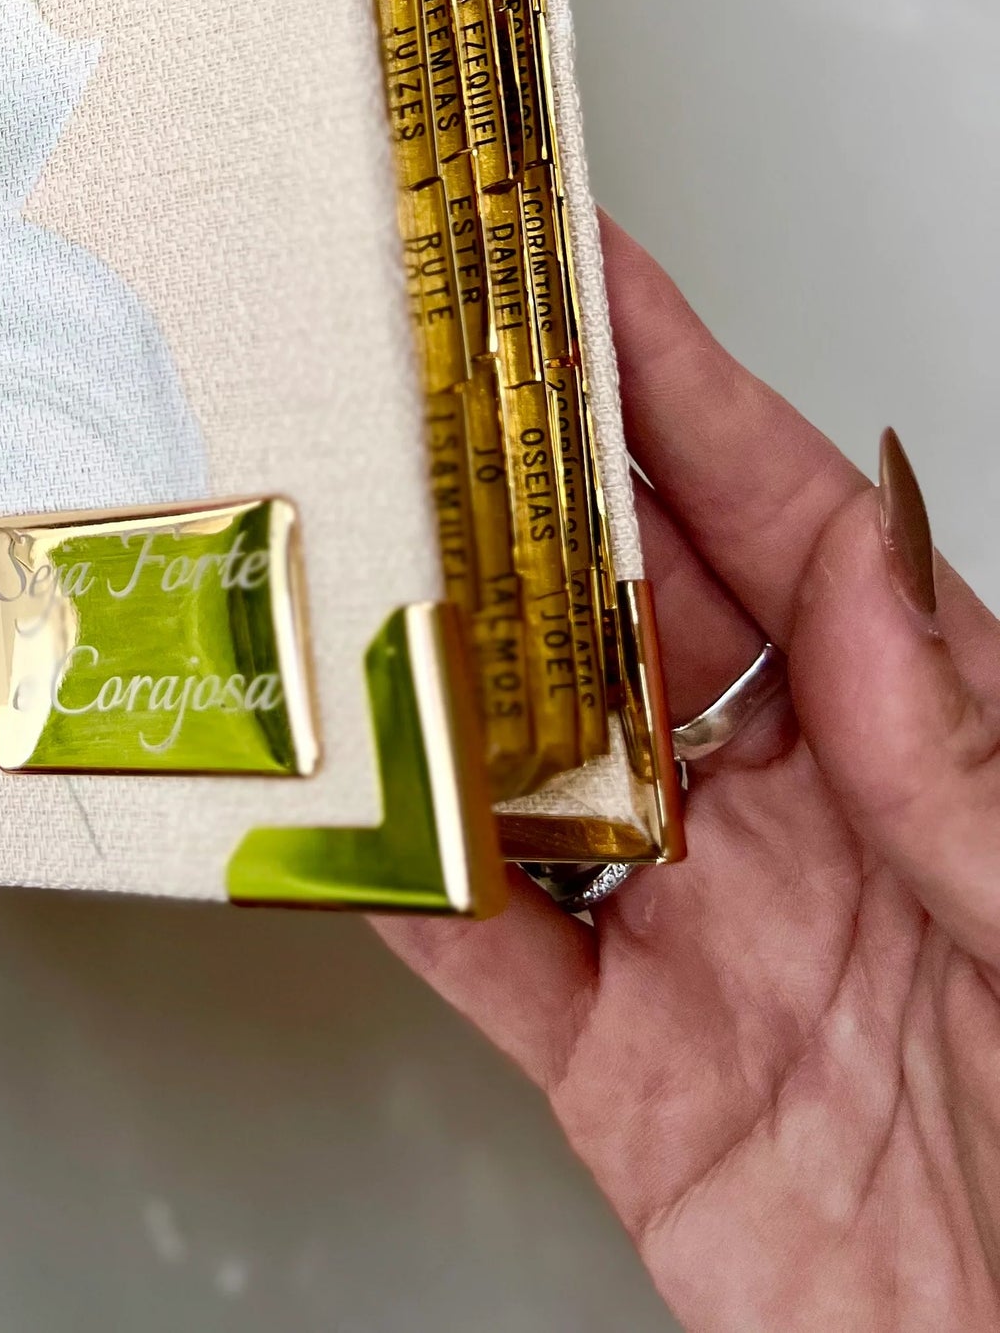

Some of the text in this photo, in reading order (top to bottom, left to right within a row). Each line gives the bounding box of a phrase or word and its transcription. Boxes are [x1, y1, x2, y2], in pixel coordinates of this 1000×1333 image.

[394, 26, 426, 140] JUÍZES
[463, 20, 497, 147] EZEQUIEL
[417, 232, 454, 324] RUTE
[449, 195, 481, 305] ESTER
[490, 222, 523, 331] DANIEL
[474, 447, 506, 483] JÓ
[520, 428, 555, 541] OSEIAS
[106, 518, 273, 599] Forte
[50, 645, 281, 752] Corajosa
[541, 611, 575, 698] JOEL
